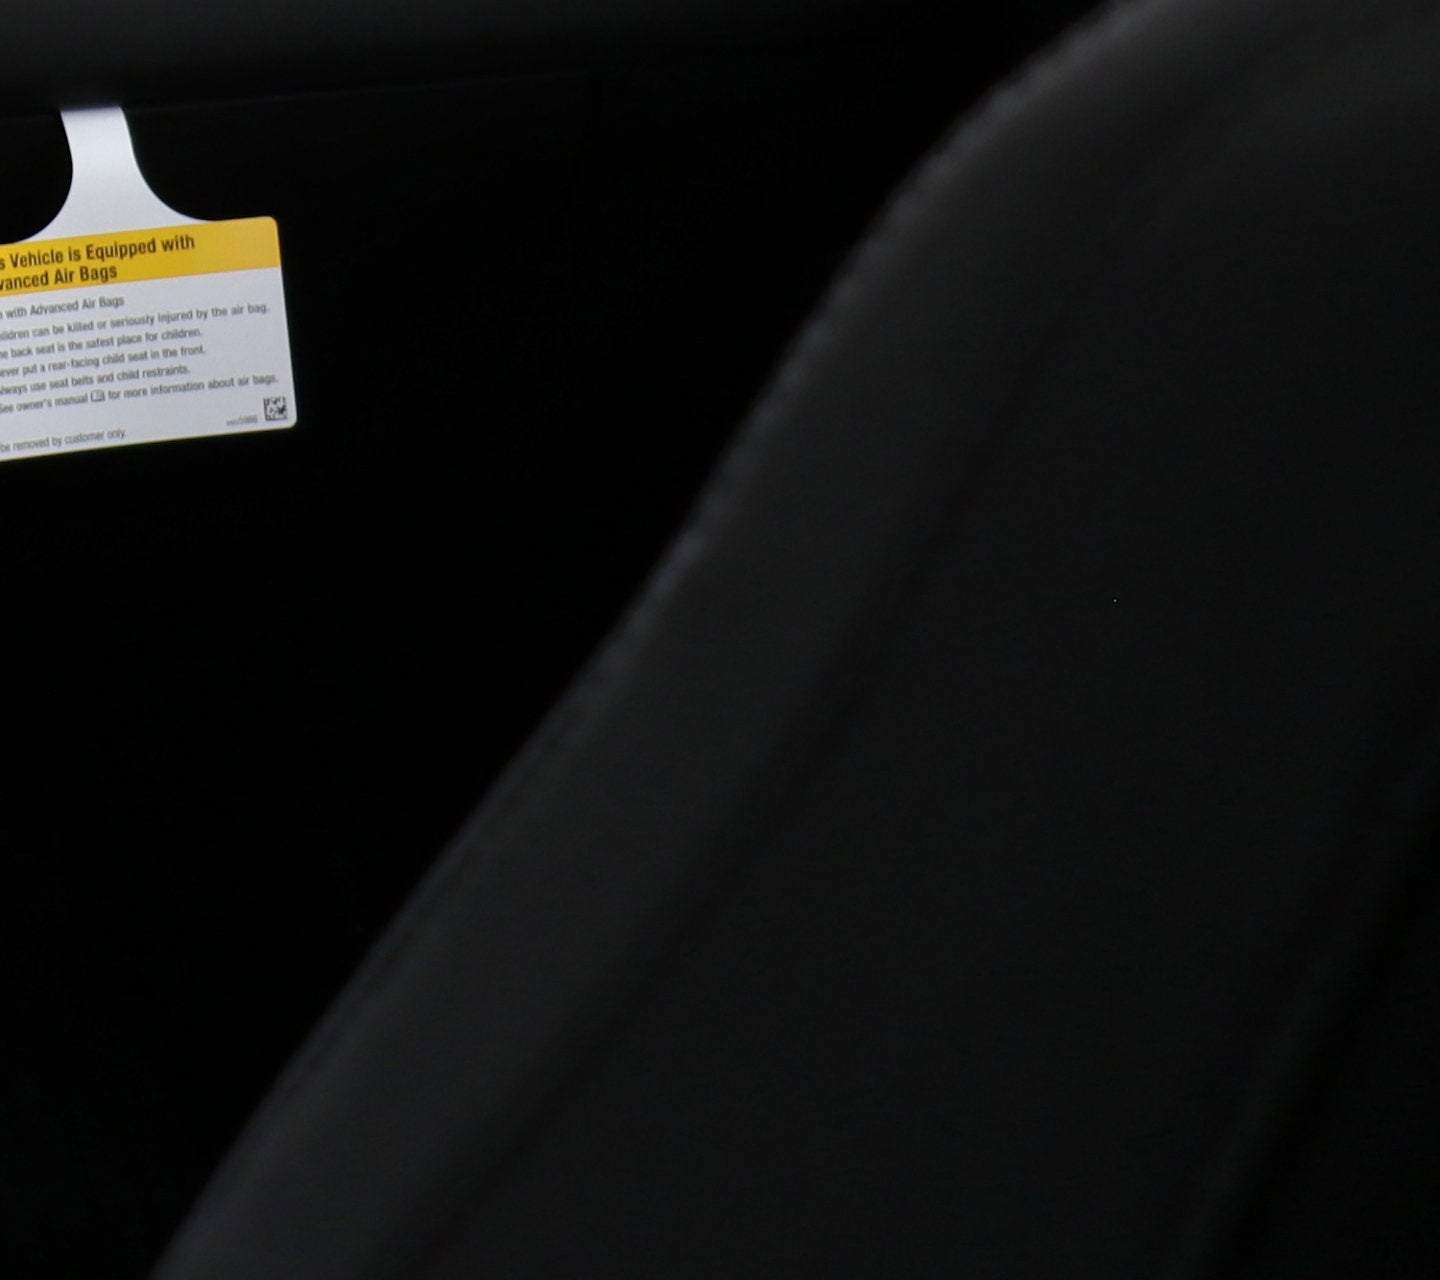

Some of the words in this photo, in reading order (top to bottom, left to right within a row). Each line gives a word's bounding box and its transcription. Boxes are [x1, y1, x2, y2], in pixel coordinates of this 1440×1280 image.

[9, 248, 63, 268] Vehicle
[68, 246, 82, 262] is
[86, 237, 156, 261] Equipped
[160, 234, 196, 252] with
[53, 268, 74, 284] Air
[79, 260, 117, 283] Bags
[5, 306, 27, 318] with
[29, 299, 79, 315] Advanced
[81, 298, 95, 309] Air
[98, 296, 124, 309] Bags
[31, 327, 49, 337] can
[51, 324, 64, 335] be
[66, 320, 94, 333] killed
[96, 320, 106, 330] or
[109, 314, 154, 328] seriously
[157, 309, 193, 324] injured
[195, 309, 208, 320] by
[210, 307, 227, 317] the
[230, 305, 243, 315] air
[247, 304, 270, 314] bag.
[10, 345, 33, 358] back
[35, 343, 55, 355] seat
[57, 342, 65, 352] is
[67, 340, 83, 351] the
[85, 336, 114, 349] safest
[116, 334, 142, 347] place
[144, 331, 157, 342] for
[160, 328, 202, 340] children.
[22, 363, 37, 376] put
[39, 364, 46, 372] a
[47, 357, 100, 371] rear-facing
[101, 352, 125, 365] child
[127, 350, 148, 362] seat
[150, 349, 159, 359] in
[161, 348, 177, 358] the
[180, 344, 205, 356] front.
[16, 398, 52, 411] owner's
[54, 393, 88, 406] manual
[107, 389, 120, 400] for
[123, 387, 147, 398] more
[150, 381, 204, 395] information
[207, 377, 235, 389] about
[237, 376, 249, 386] air
[252, 374, 278, 385] bags.
[29, 382, 46, 392] use
[48, 377, 68, 390] seat
[70, 375, 94, 386] belts
[96, 372, 114, 384] and
[116, 368, 139, 381] child
[142, 364, 190, 378] restraints.
[0, 443, 10, 453] be
[12, 436, 49, 450] removed
[51, 436, 62, 447] by
[63, 431, 104, 444] customer
[106, 428, 126, 440] only.
